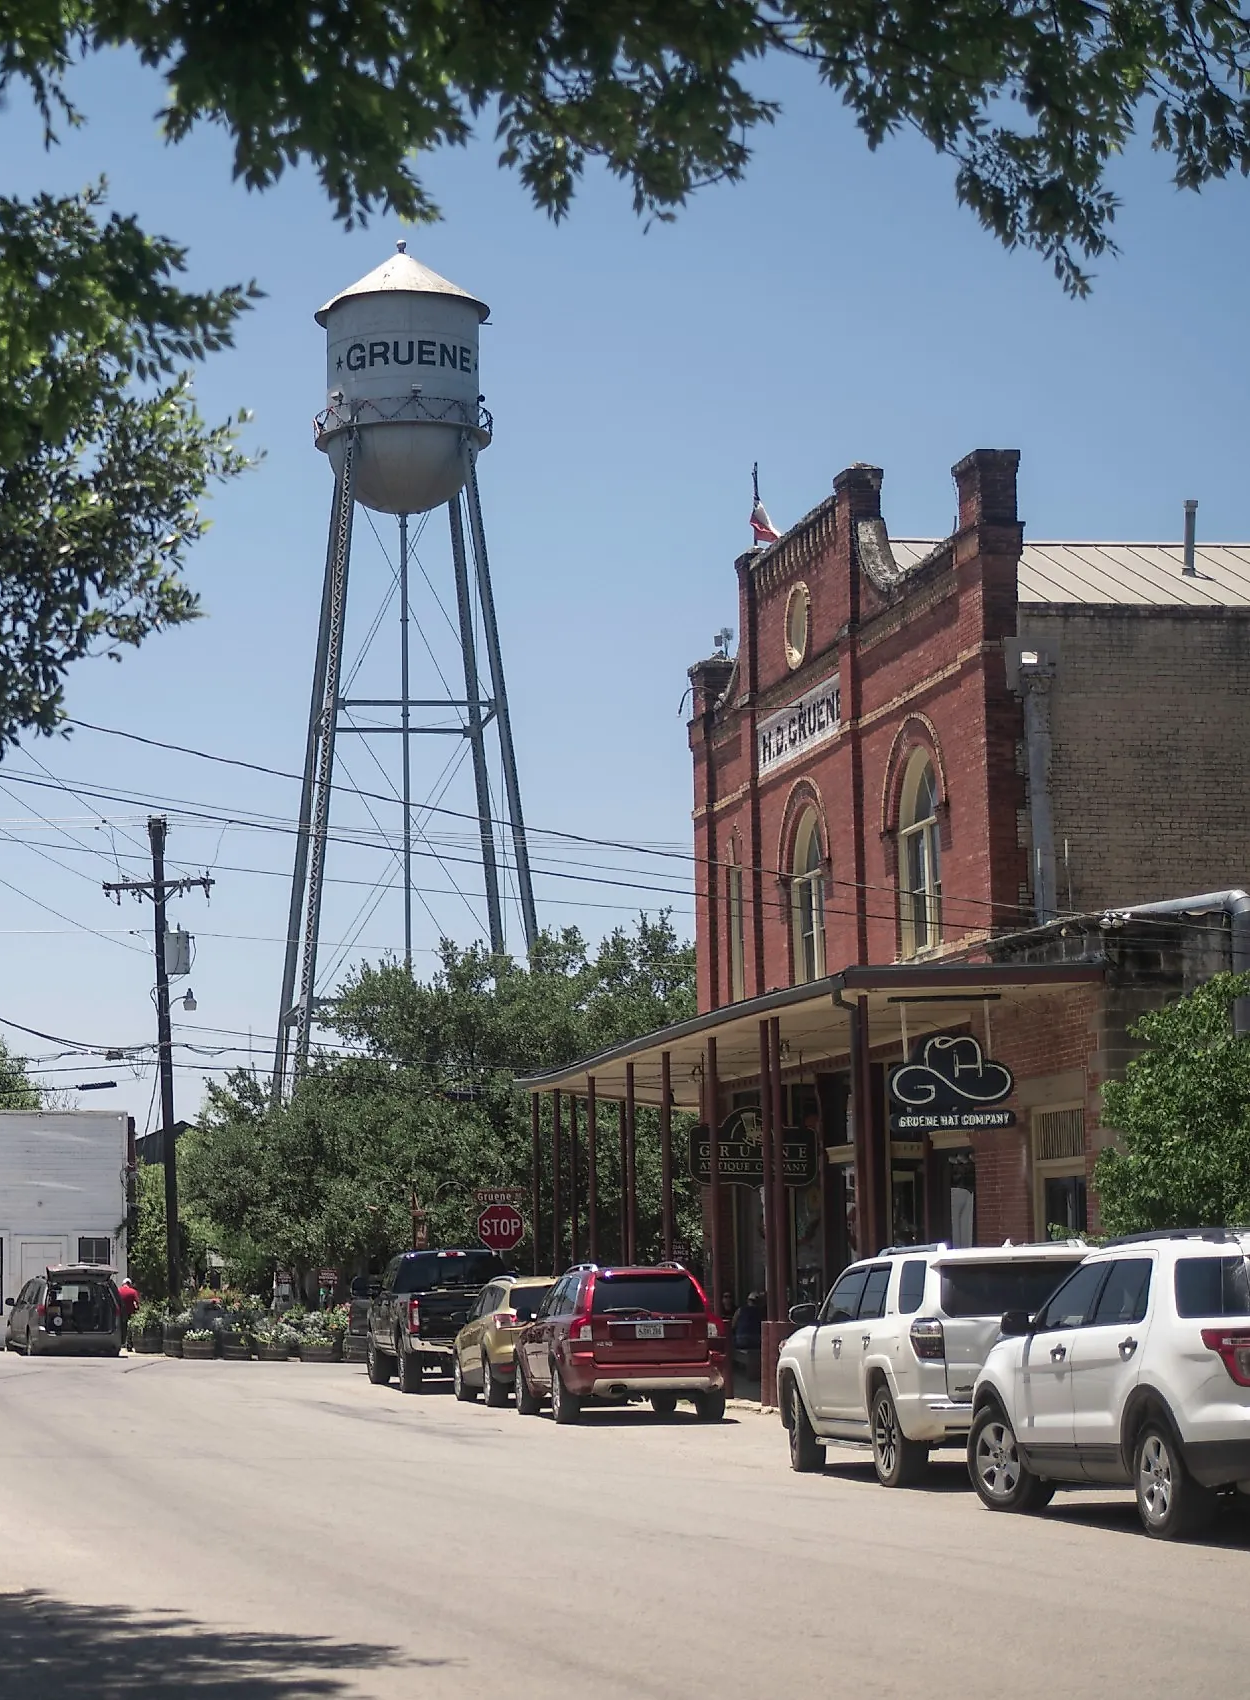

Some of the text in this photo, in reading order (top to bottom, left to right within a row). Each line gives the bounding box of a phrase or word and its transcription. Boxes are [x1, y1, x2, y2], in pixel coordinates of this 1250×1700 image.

[346, 340, 472, 373] GRUENE
[898, 1112, 1010, 1128] GRUENE HAT COMPANY
[477, 1192, 512, 1201] Gruene
[481, 1218, 521, 1236] STOP
